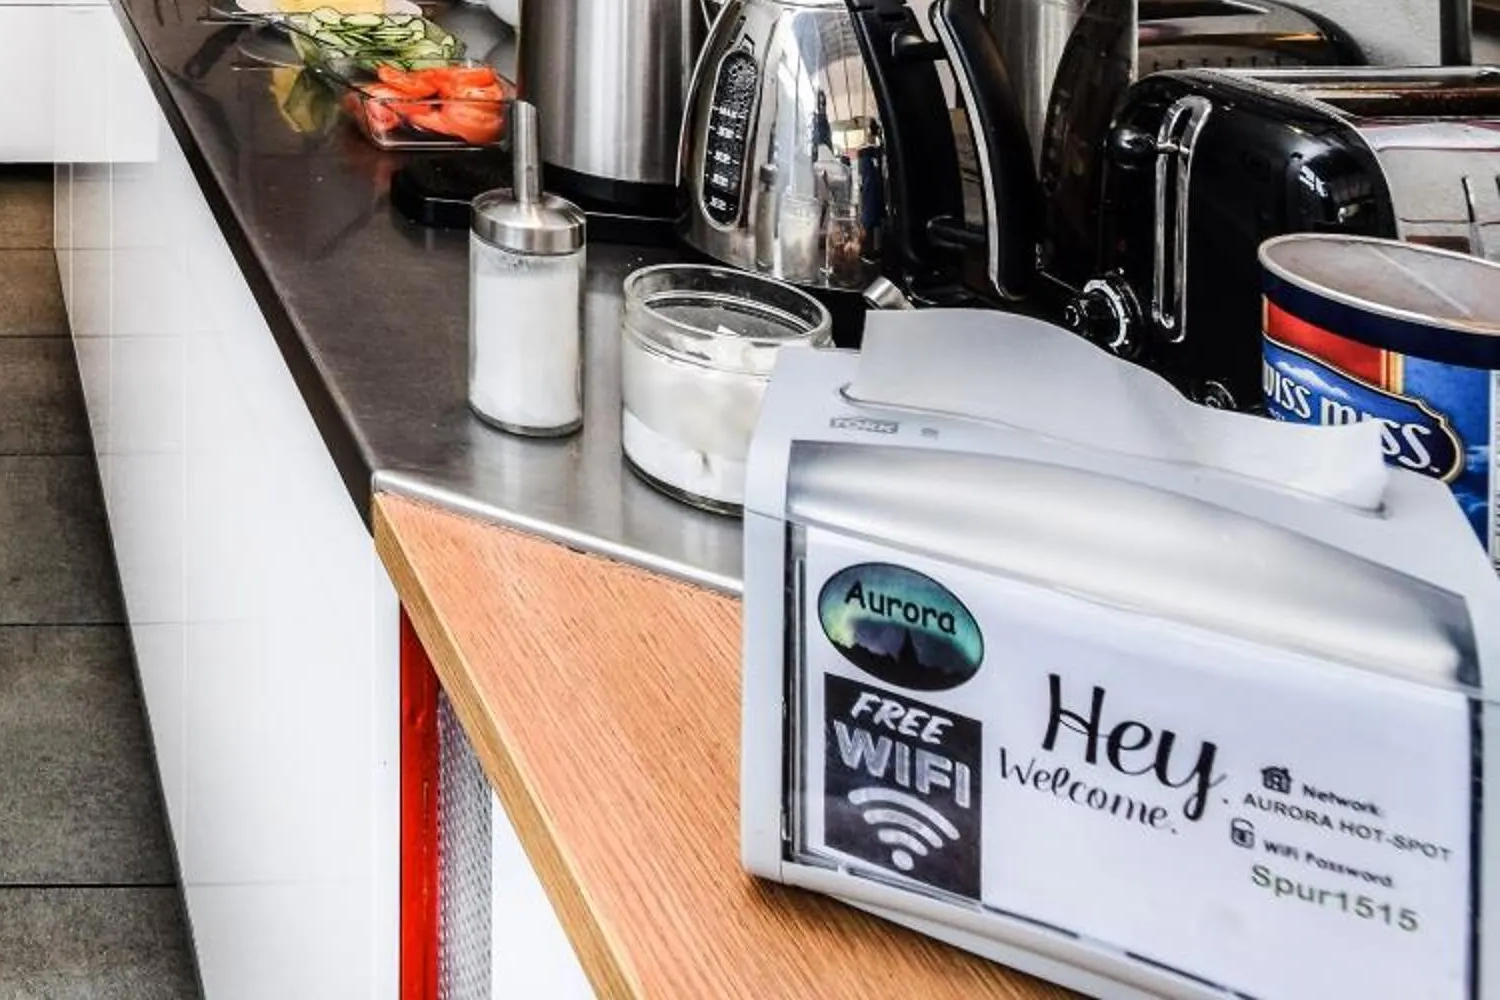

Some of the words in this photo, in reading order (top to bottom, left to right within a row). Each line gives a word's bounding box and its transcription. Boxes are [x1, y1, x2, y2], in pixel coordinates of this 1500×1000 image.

[844, 580, 957, 635] Aurora
[851, 691, 954, 744] FREE
[833, 719, 971, 809] WIFI
[1243, 792, 1334, 830] AURORA
[1338, 819, 1453, 862] HOT-SPOT
[1250, 863, 1419, 932] Spur1515
